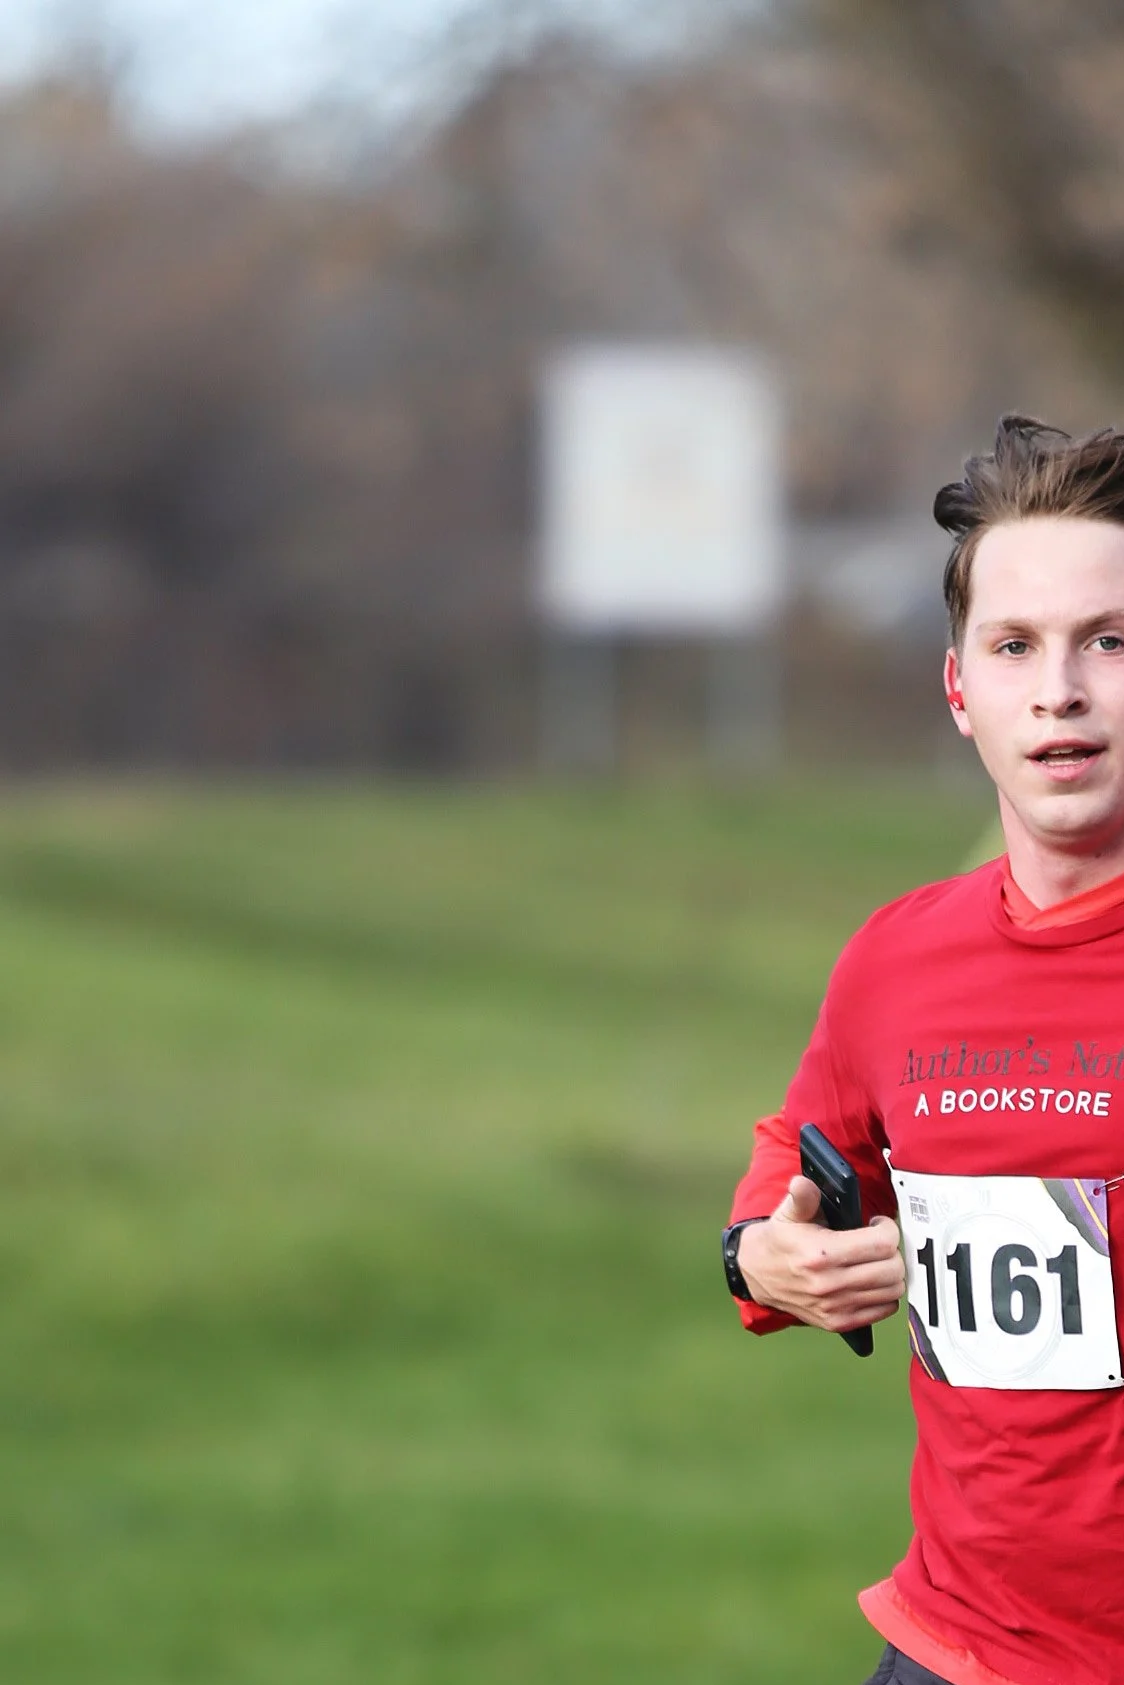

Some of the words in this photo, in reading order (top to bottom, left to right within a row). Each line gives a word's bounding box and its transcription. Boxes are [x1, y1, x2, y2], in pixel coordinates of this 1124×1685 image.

[899, 1036, 1051, 1086] Author's
[914, 1093, 930, 1117] A
[940, 1087, 1113, 1117] BOOKSTORE
[917, 1238, 1083, 1336] 1161
